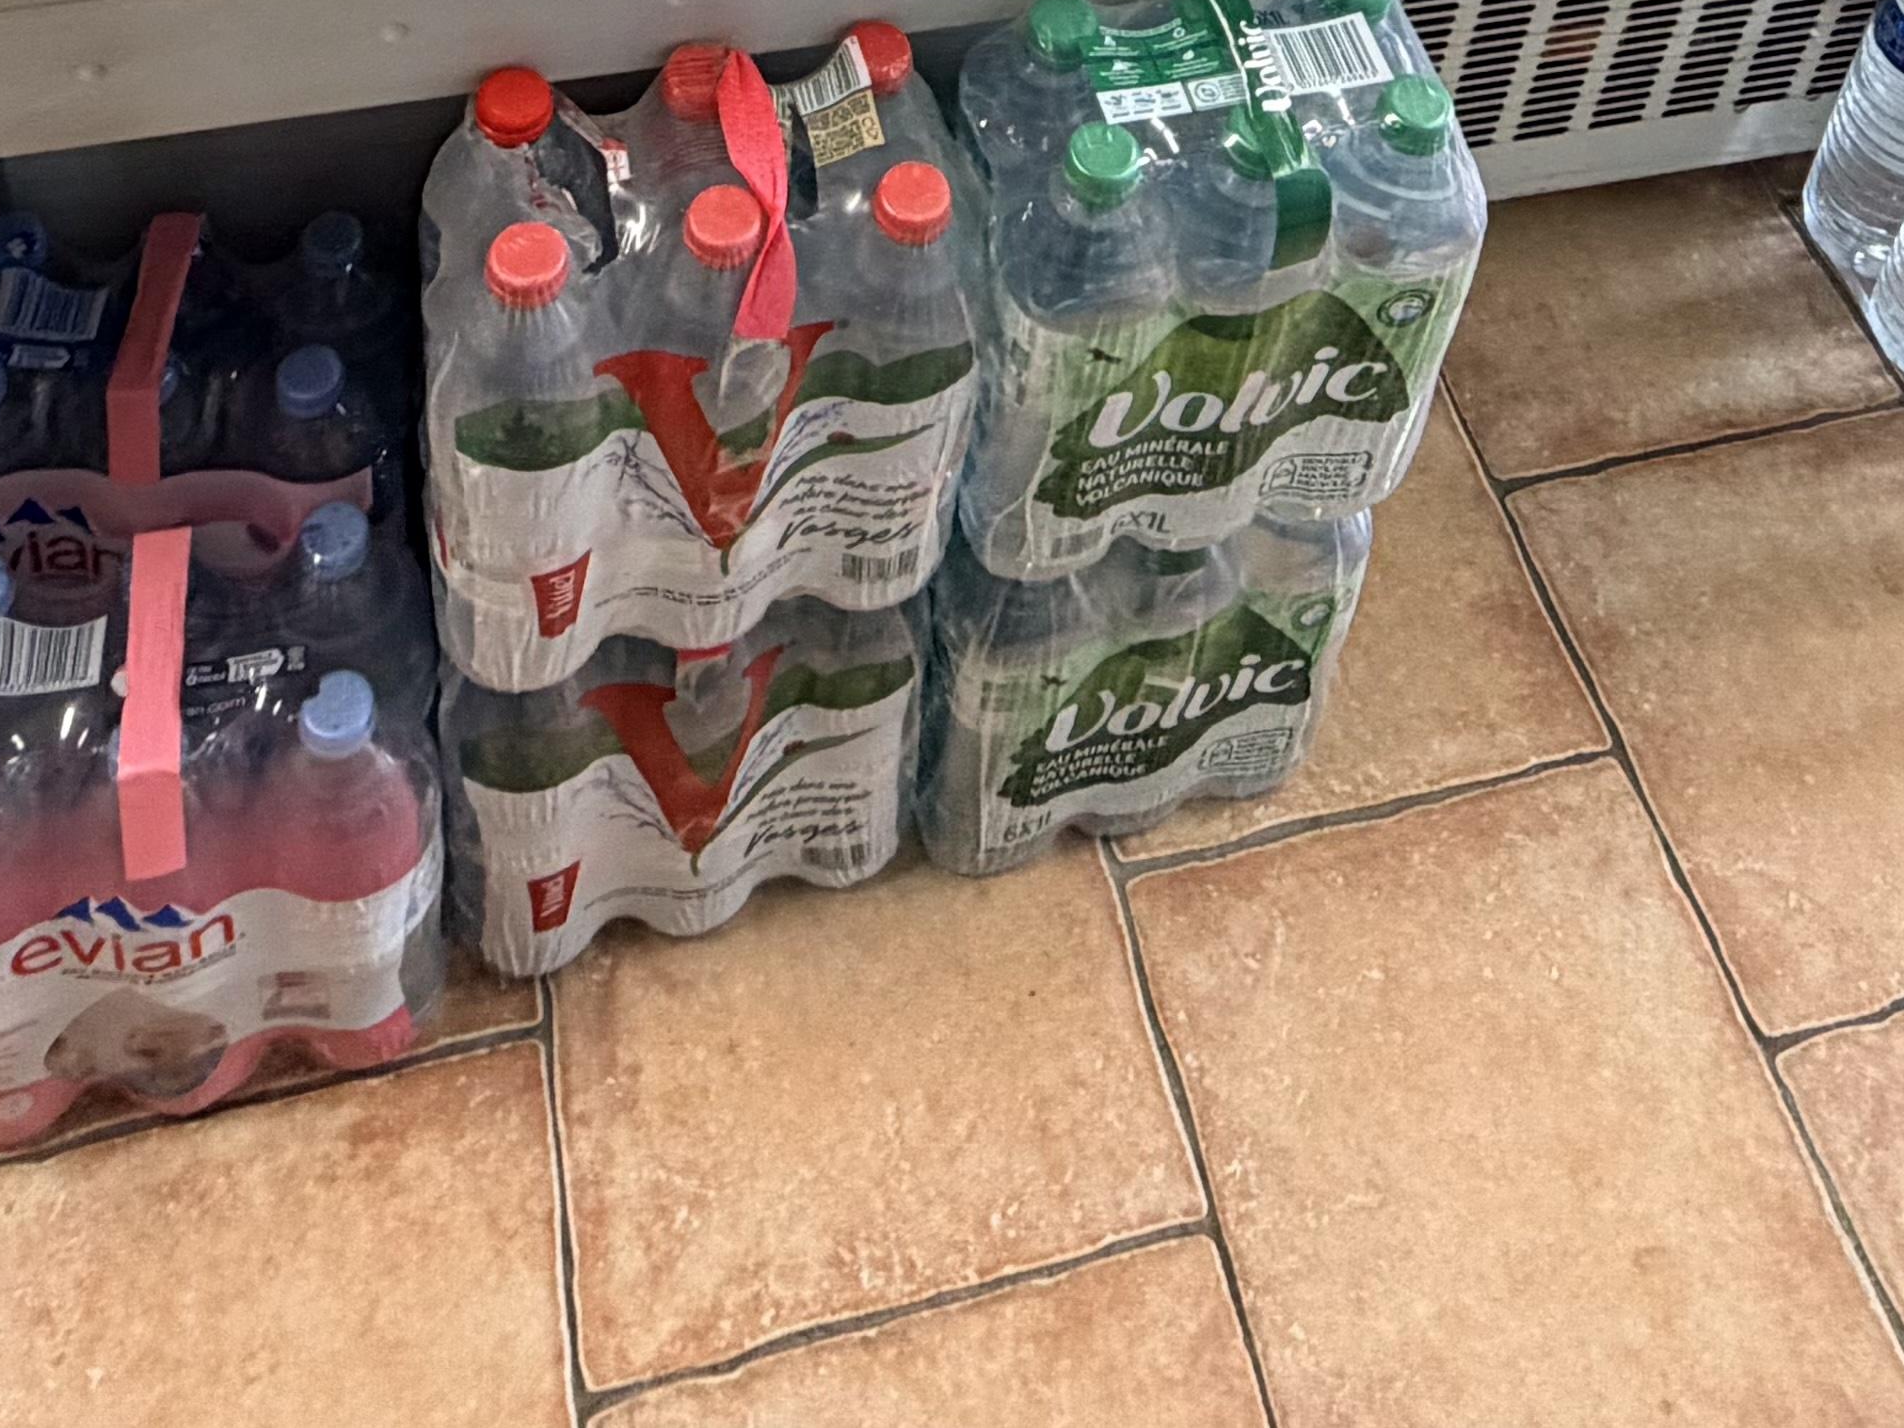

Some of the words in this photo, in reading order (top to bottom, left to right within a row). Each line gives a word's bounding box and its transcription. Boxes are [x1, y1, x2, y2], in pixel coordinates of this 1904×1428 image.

[1239, 19, 1293, 114] Volvic
[1088, 346, 1387, 448] Volvic
[1077, 455, 1193, 491] NATURELLE
[1081, 451, 1120, 474] EAU
[1125, 435, 1229, 457] MINÉRALE
[1075, 472, 1204, 507] VOLCANIQUE
[777, 515, 925, 551] Vosges
[1045, 654, 1305, 752] Volvic
[1033, 752, 1136, 786] NATURELLE
[1036, 750, 1074, 773] EAU
[1030, 764, 1147, 799] VOLCANIQUE
[744, 820, 864, 858] Vosges
[10, 913, 236, 977] evian
